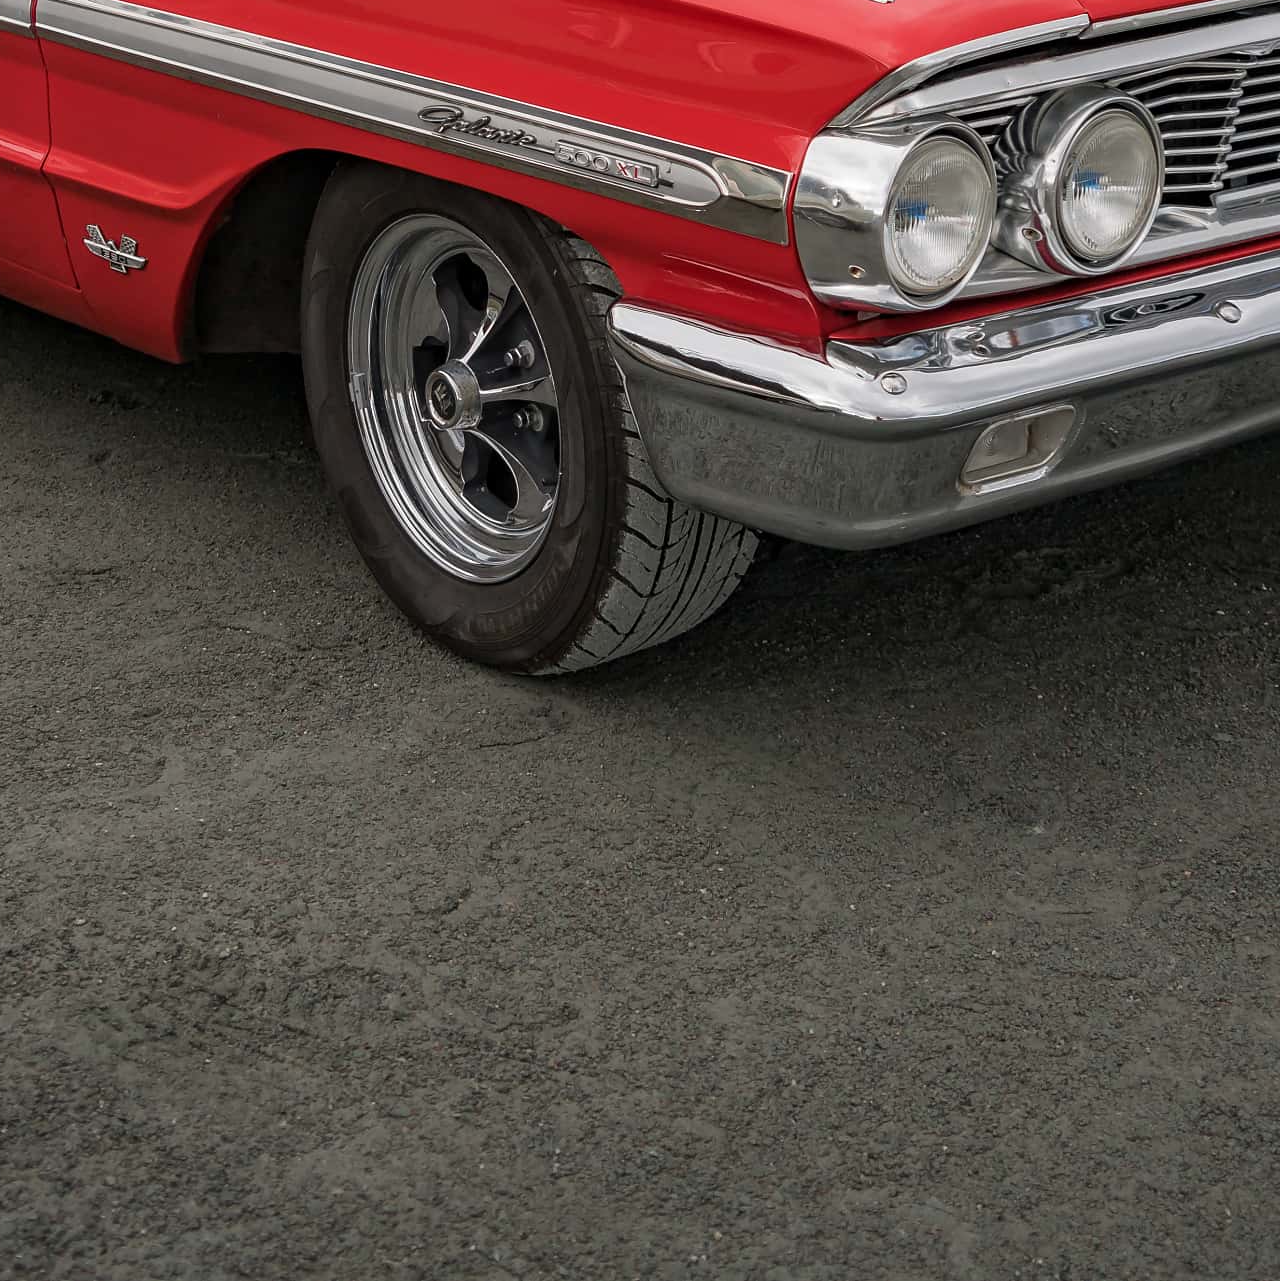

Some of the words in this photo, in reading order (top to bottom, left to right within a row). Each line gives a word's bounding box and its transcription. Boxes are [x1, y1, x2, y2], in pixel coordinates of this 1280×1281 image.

[417, 104, 538, 147] Galaxie
[556, 143, 610, 172] 500
[615, 158, 652, 184] XL
